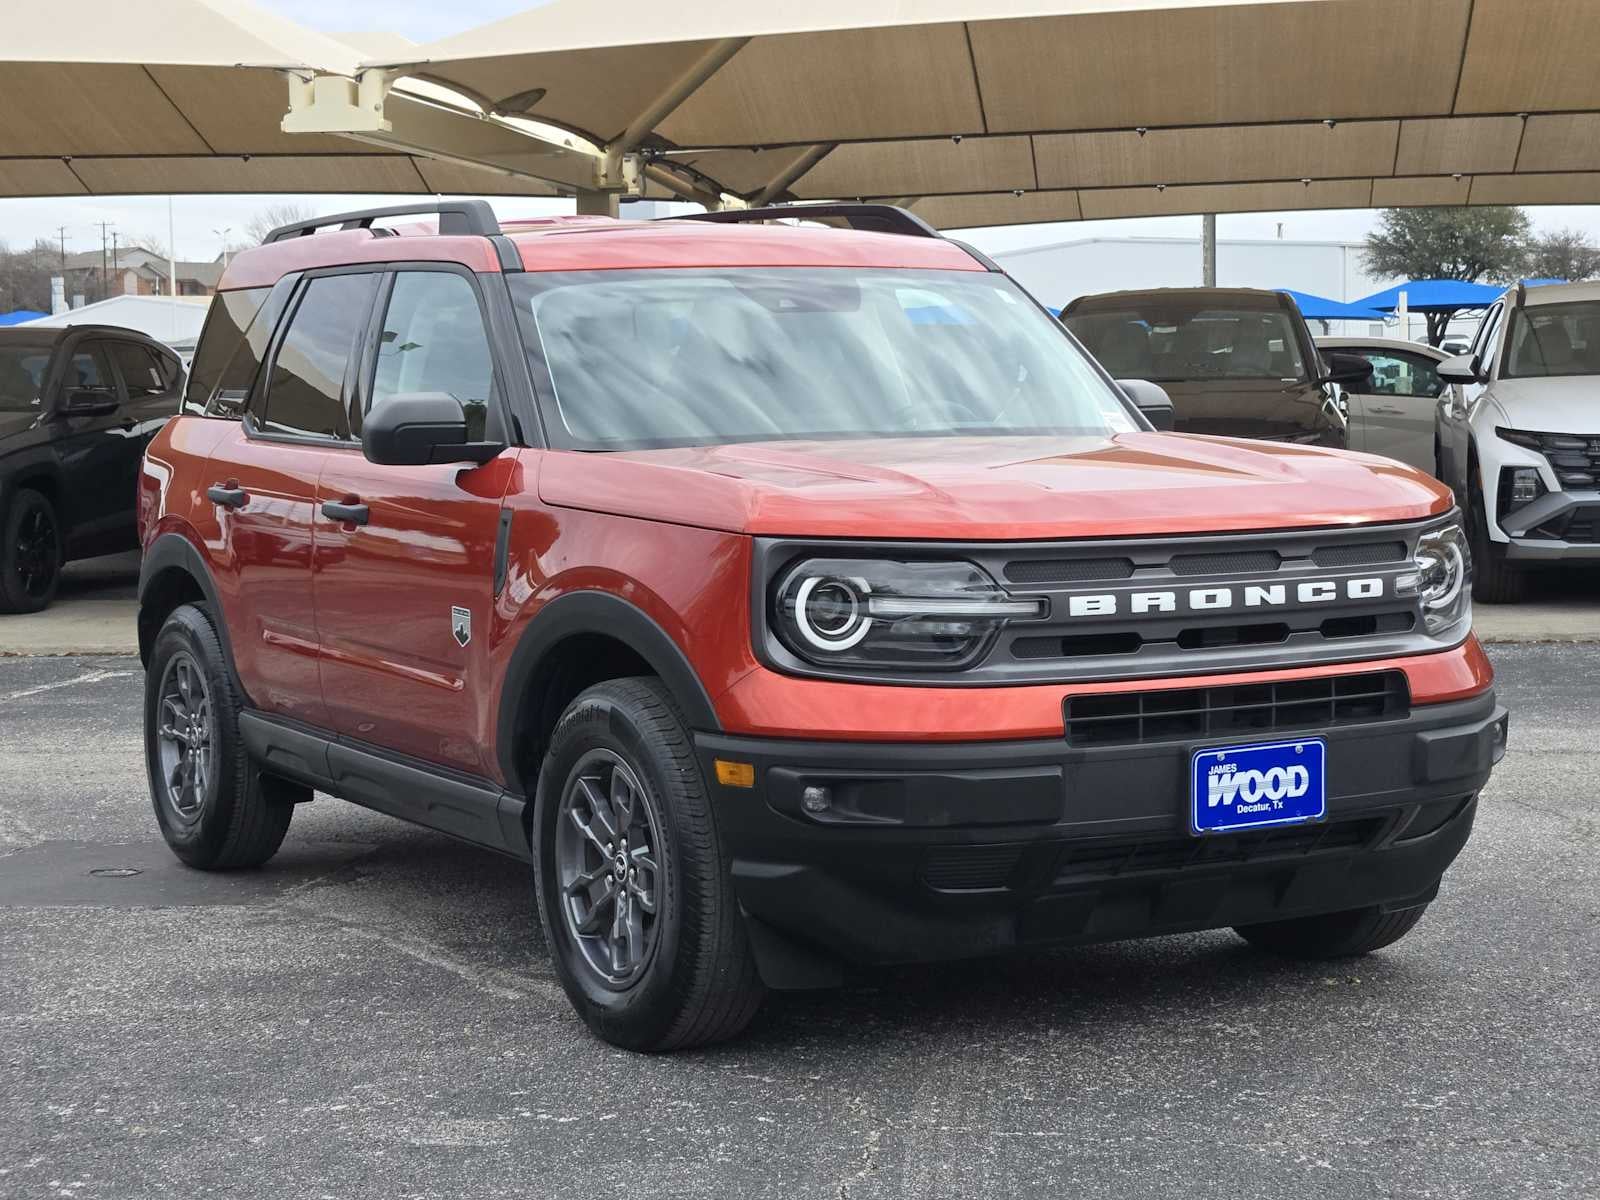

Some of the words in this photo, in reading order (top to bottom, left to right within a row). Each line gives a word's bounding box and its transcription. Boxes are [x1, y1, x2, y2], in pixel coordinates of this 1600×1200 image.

[1069, 578, 1383, 617] BRONCO
[1208, 763, 1237, 775] JAMES
[1208, 765, 1309, 807] WOOD
[1237, 802, 1271, 814] Decatur,
[1273, 801, 1283, 810] Tx
